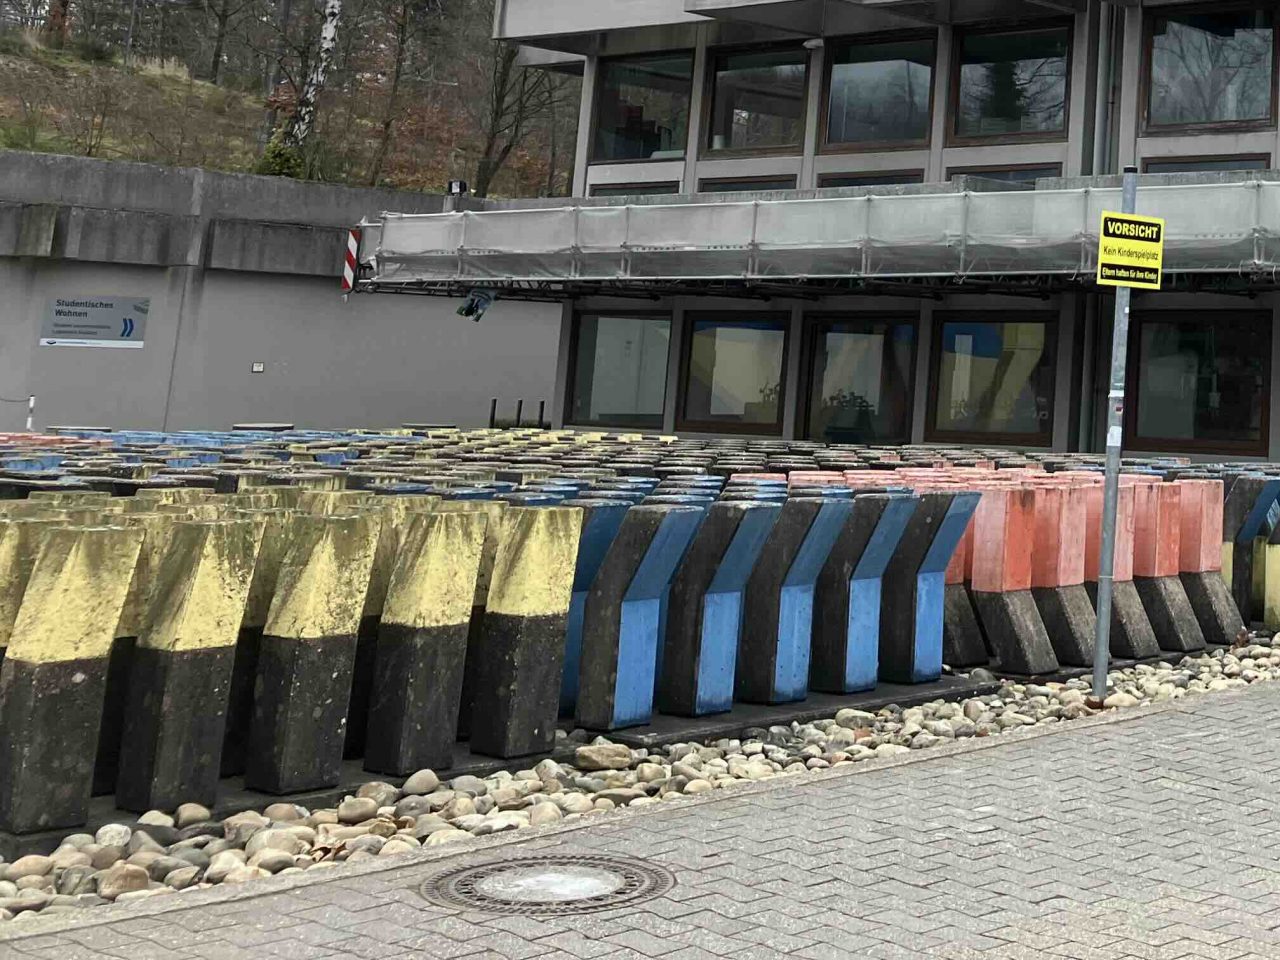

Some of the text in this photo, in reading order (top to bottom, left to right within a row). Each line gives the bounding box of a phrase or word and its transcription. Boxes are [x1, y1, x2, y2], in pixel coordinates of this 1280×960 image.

[1107, 220, 1158, 239] VORSICHT
[1103, 245, 1159, 261] Kein Kinderspielplatz
[55, 309, 88, 318] Wohnen
